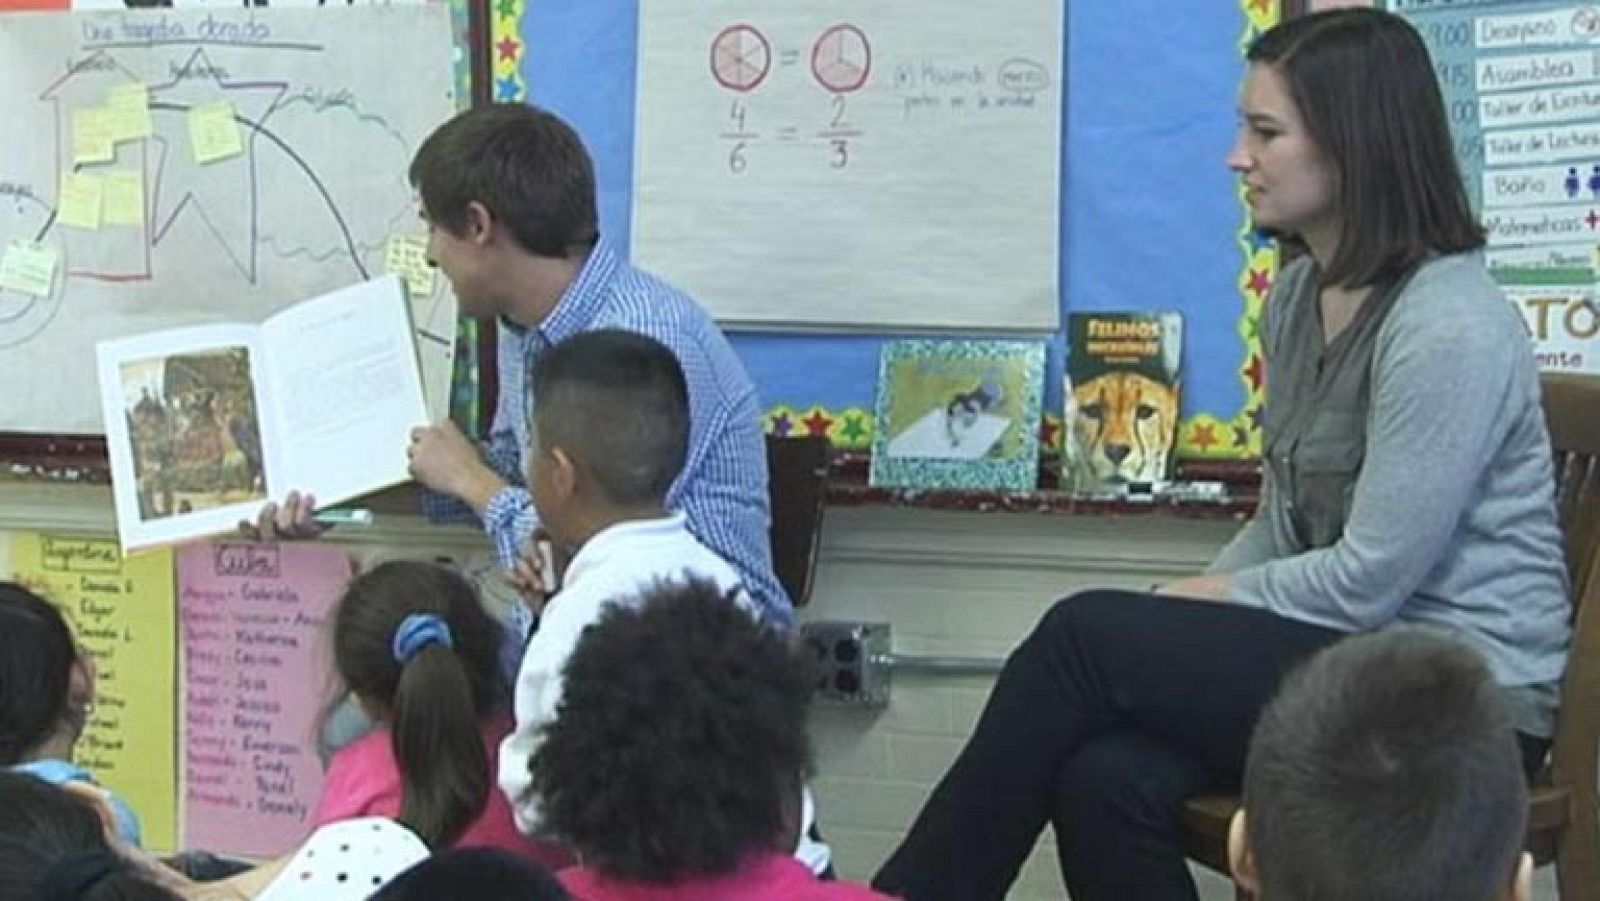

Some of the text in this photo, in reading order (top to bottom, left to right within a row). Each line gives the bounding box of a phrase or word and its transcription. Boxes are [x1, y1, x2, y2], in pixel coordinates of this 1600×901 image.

[1481, 58, 1576, 85] Asamblea
[729, 100, 746, 132] 4
[829, 97, 848, 129] 2
[728, 142, 747, 173] 6
[830, 138, 848, 170] 3
[1494, 175, 1546, 195] Baño
